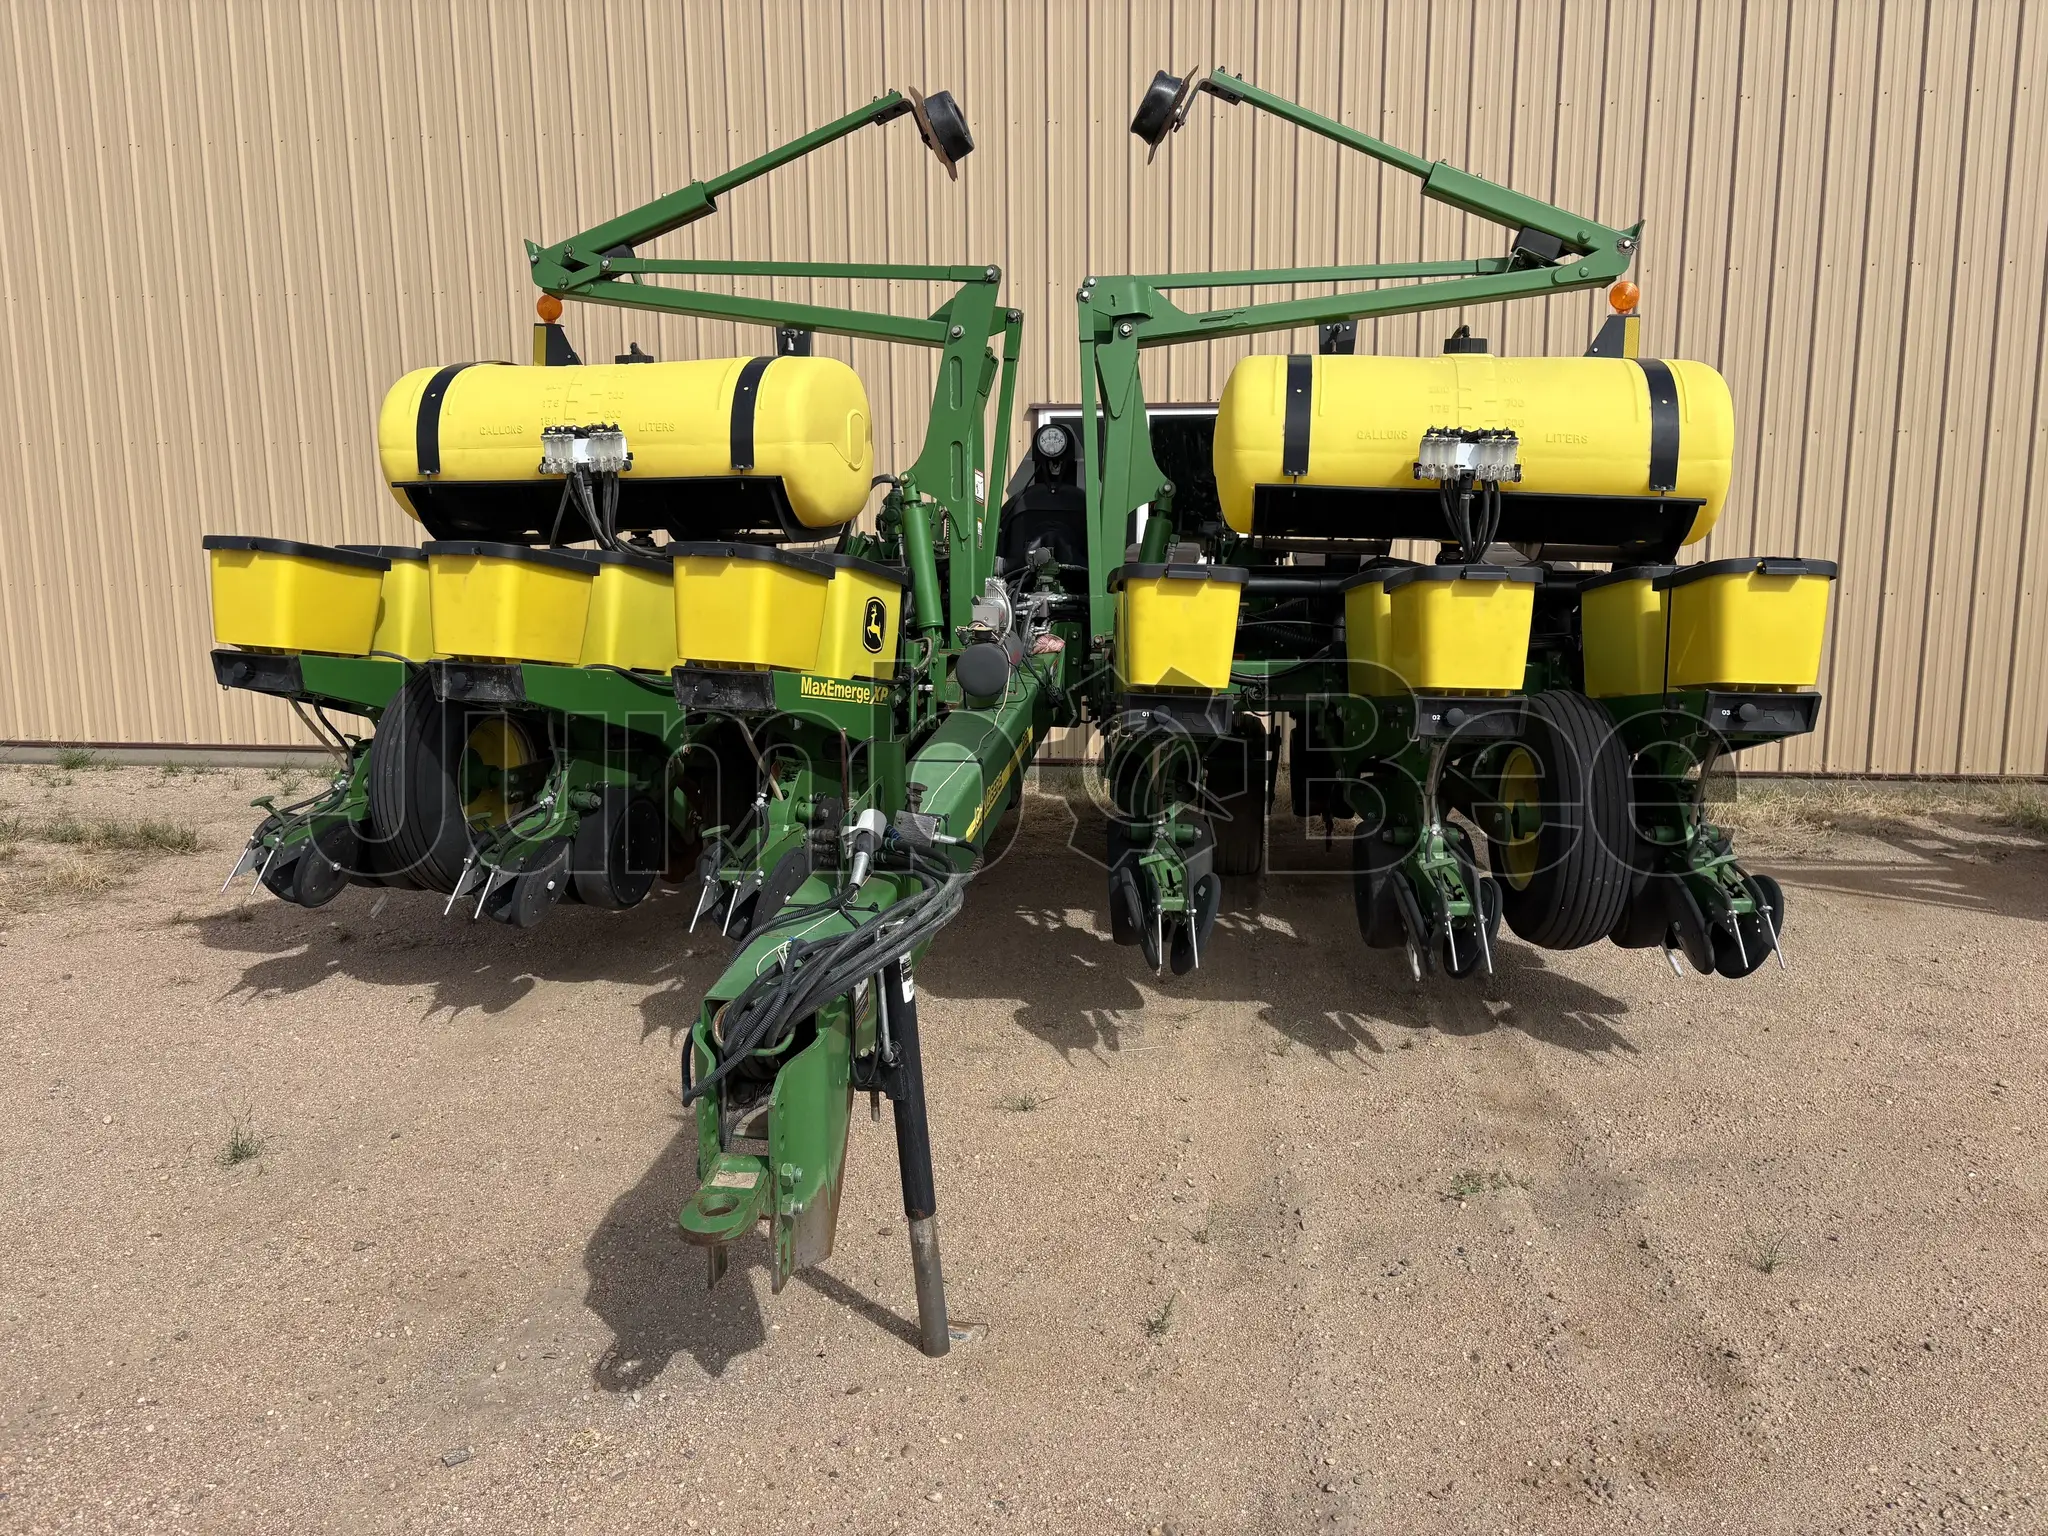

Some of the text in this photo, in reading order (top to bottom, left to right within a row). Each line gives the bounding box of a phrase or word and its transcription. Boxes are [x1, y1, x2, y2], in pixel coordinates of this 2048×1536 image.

[479, 424, 524, 435] GALLONS
[637, 420, 676, 433] LITERS
[1356, 429, 1408, 441] GALLONS
[1545, 433, 1589, 444] LITERS
[800, 676, 889, 705] MaxEmerge XP
